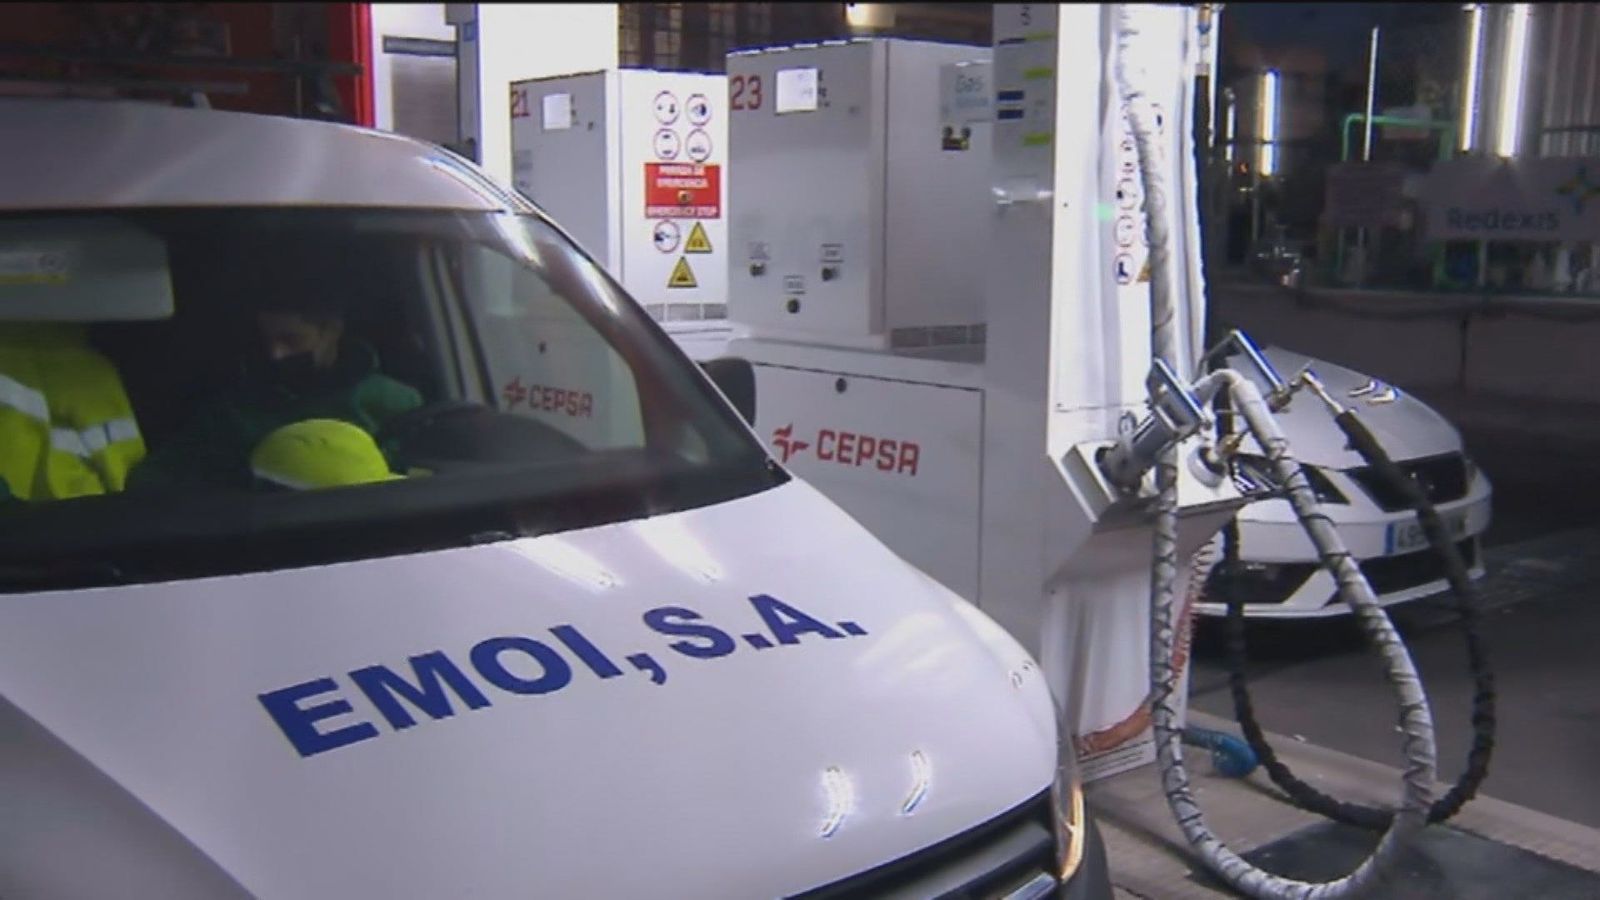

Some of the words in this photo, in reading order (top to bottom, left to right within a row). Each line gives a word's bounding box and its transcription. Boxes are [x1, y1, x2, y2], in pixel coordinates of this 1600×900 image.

[510, 89, 531, 119] 21
[730, 74, 763, 111] 23
[528, 383, 593, 417] CEPSA
[816, 428, 921, 477] CEPSA
